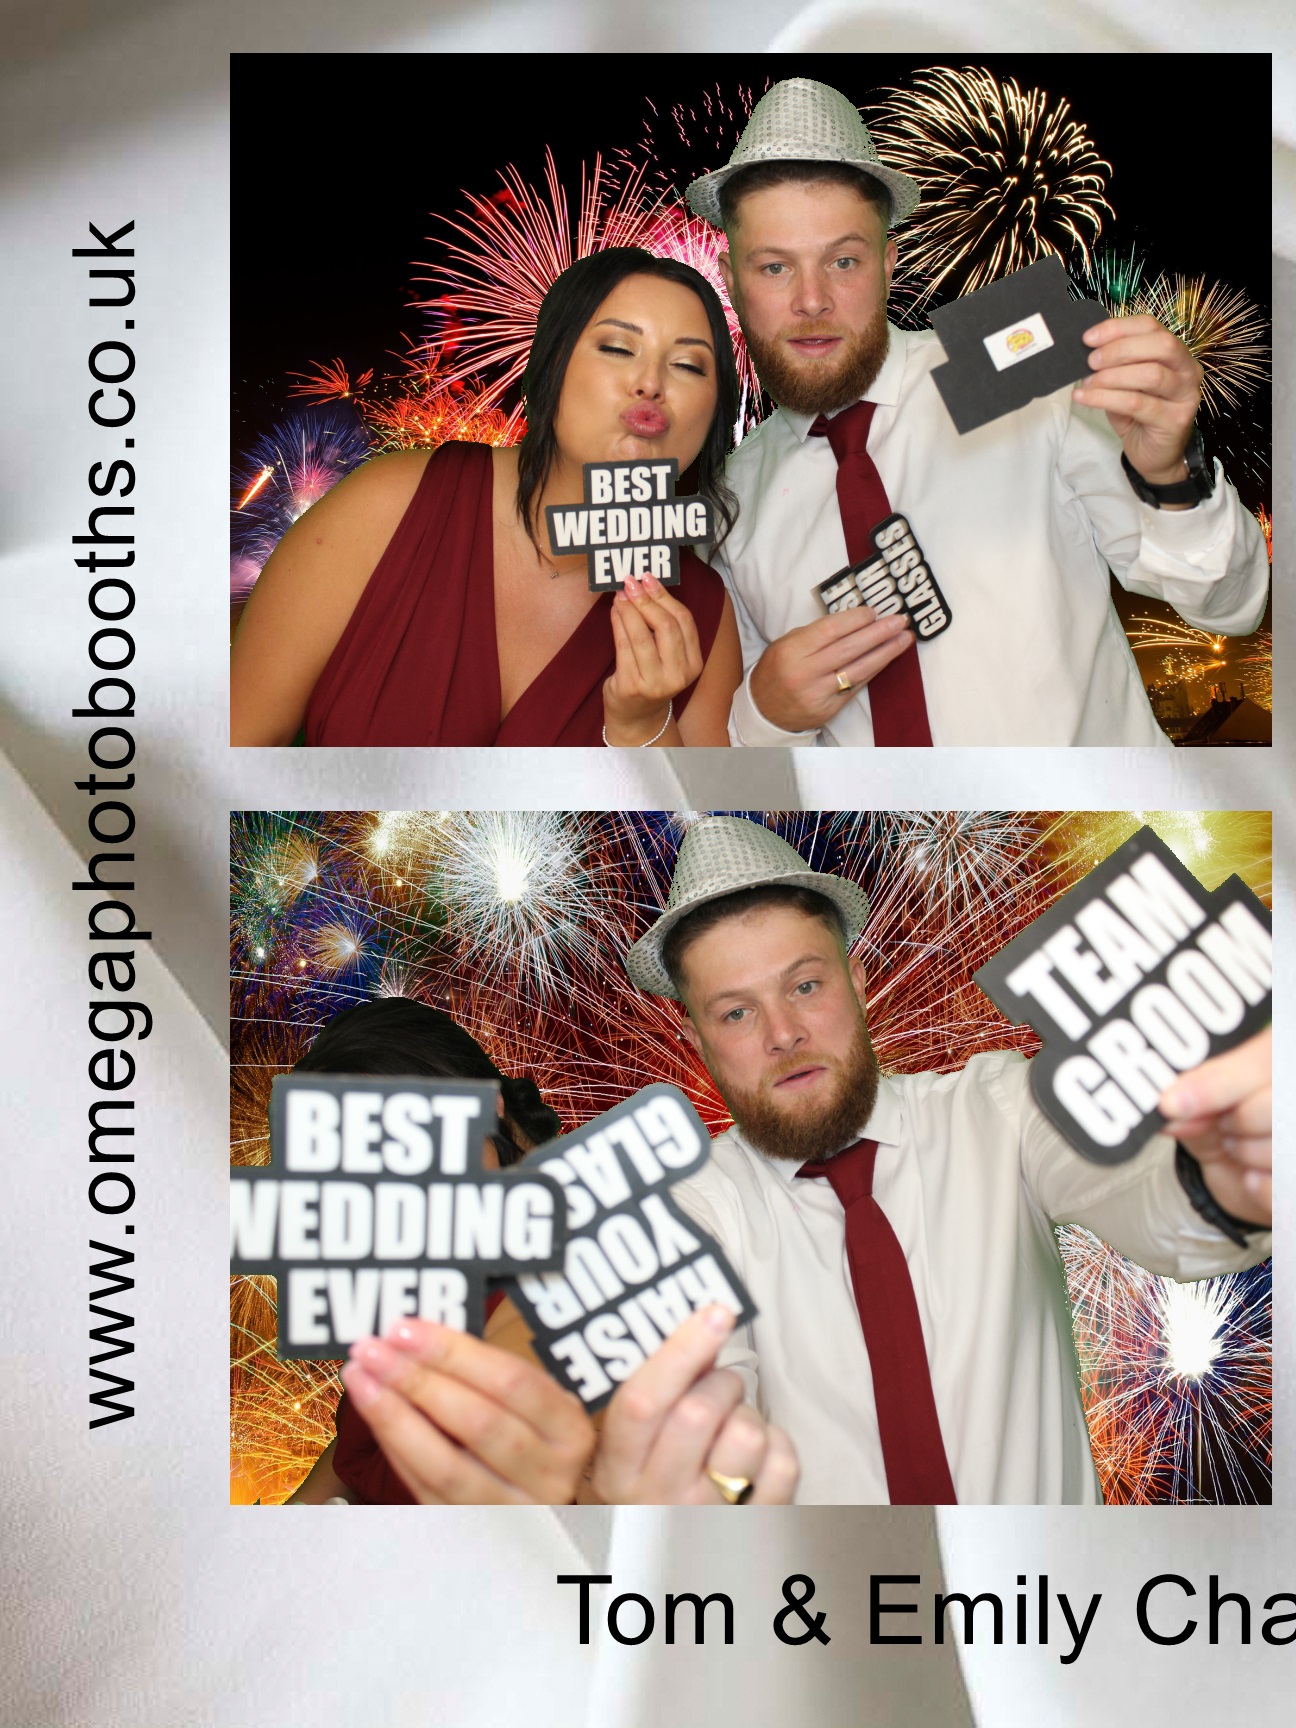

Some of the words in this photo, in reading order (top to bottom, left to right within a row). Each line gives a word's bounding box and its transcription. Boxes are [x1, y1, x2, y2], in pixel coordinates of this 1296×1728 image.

[591, 465, 671, 504] BEST
[553, 502, 707, 547] WEDDING
[594, 545, 671, 584] EVER
[855, 558, 908, 621] OUR
[875, 518, 947, 636] GLASSES
[1004, 851, 1207, 1042] TEAM
[285, 1089, 481, 1175] BEST
[538, 1095, 702, 1231] GLAS
